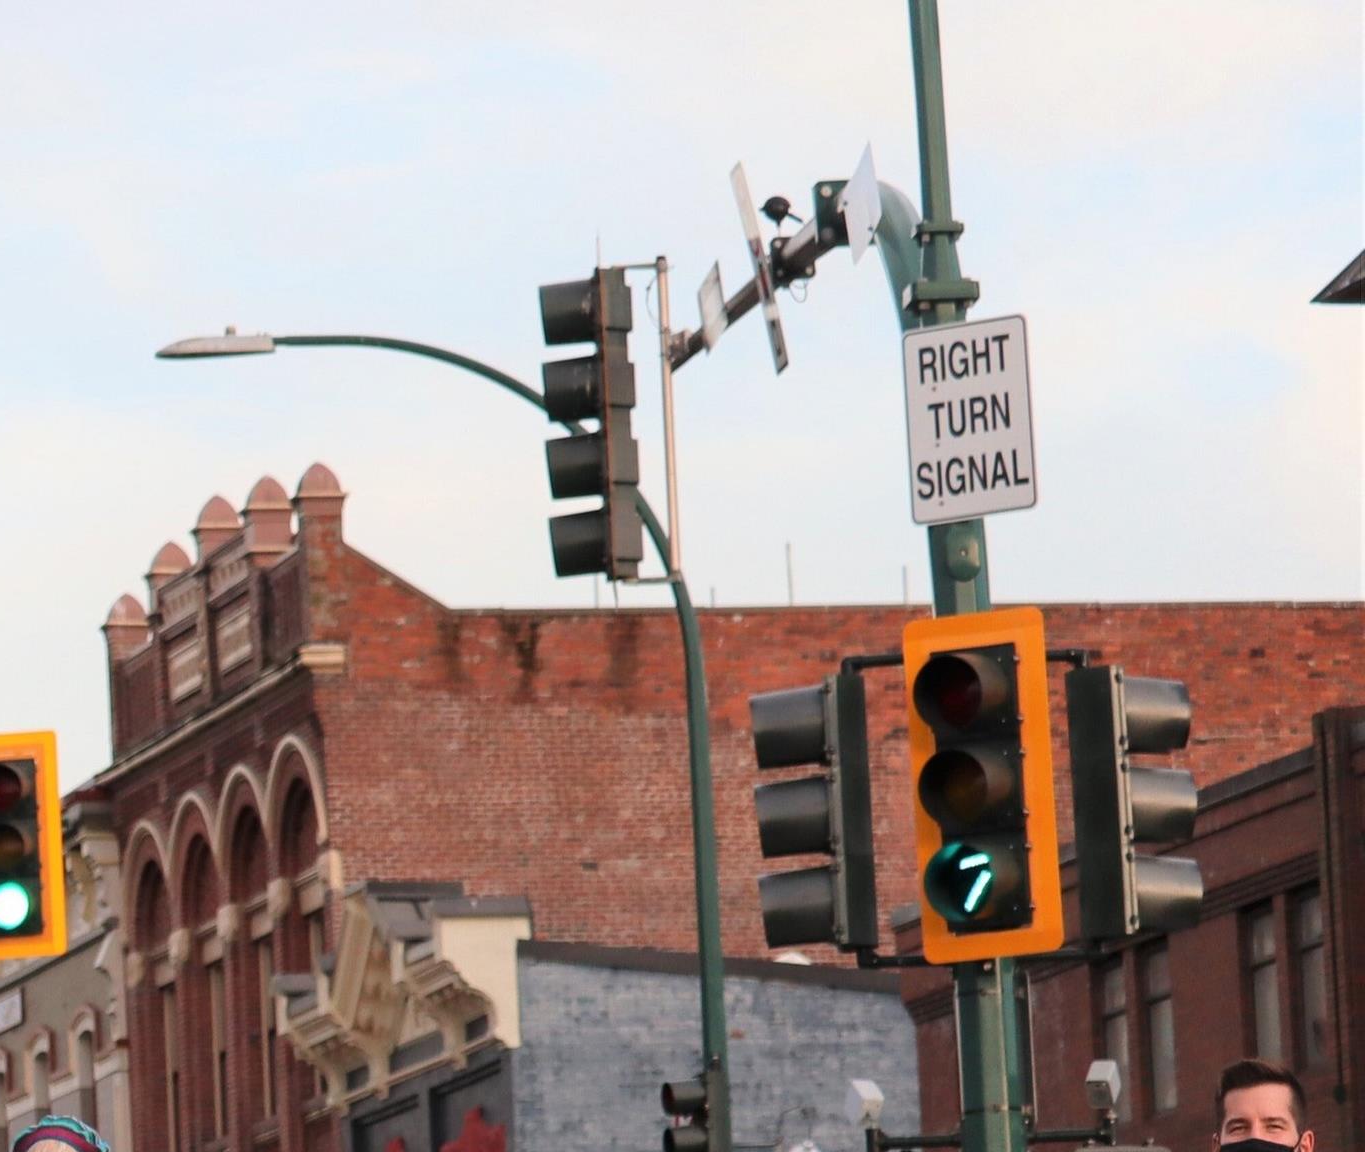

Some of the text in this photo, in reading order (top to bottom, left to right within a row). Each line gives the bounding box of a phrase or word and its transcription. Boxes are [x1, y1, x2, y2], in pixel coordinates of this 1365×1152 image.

[918, 334, 1010, 384] RIGHT
[927, 392, 1011, 440] TURN
[916, 448, 1030, 500] SIGNAL
